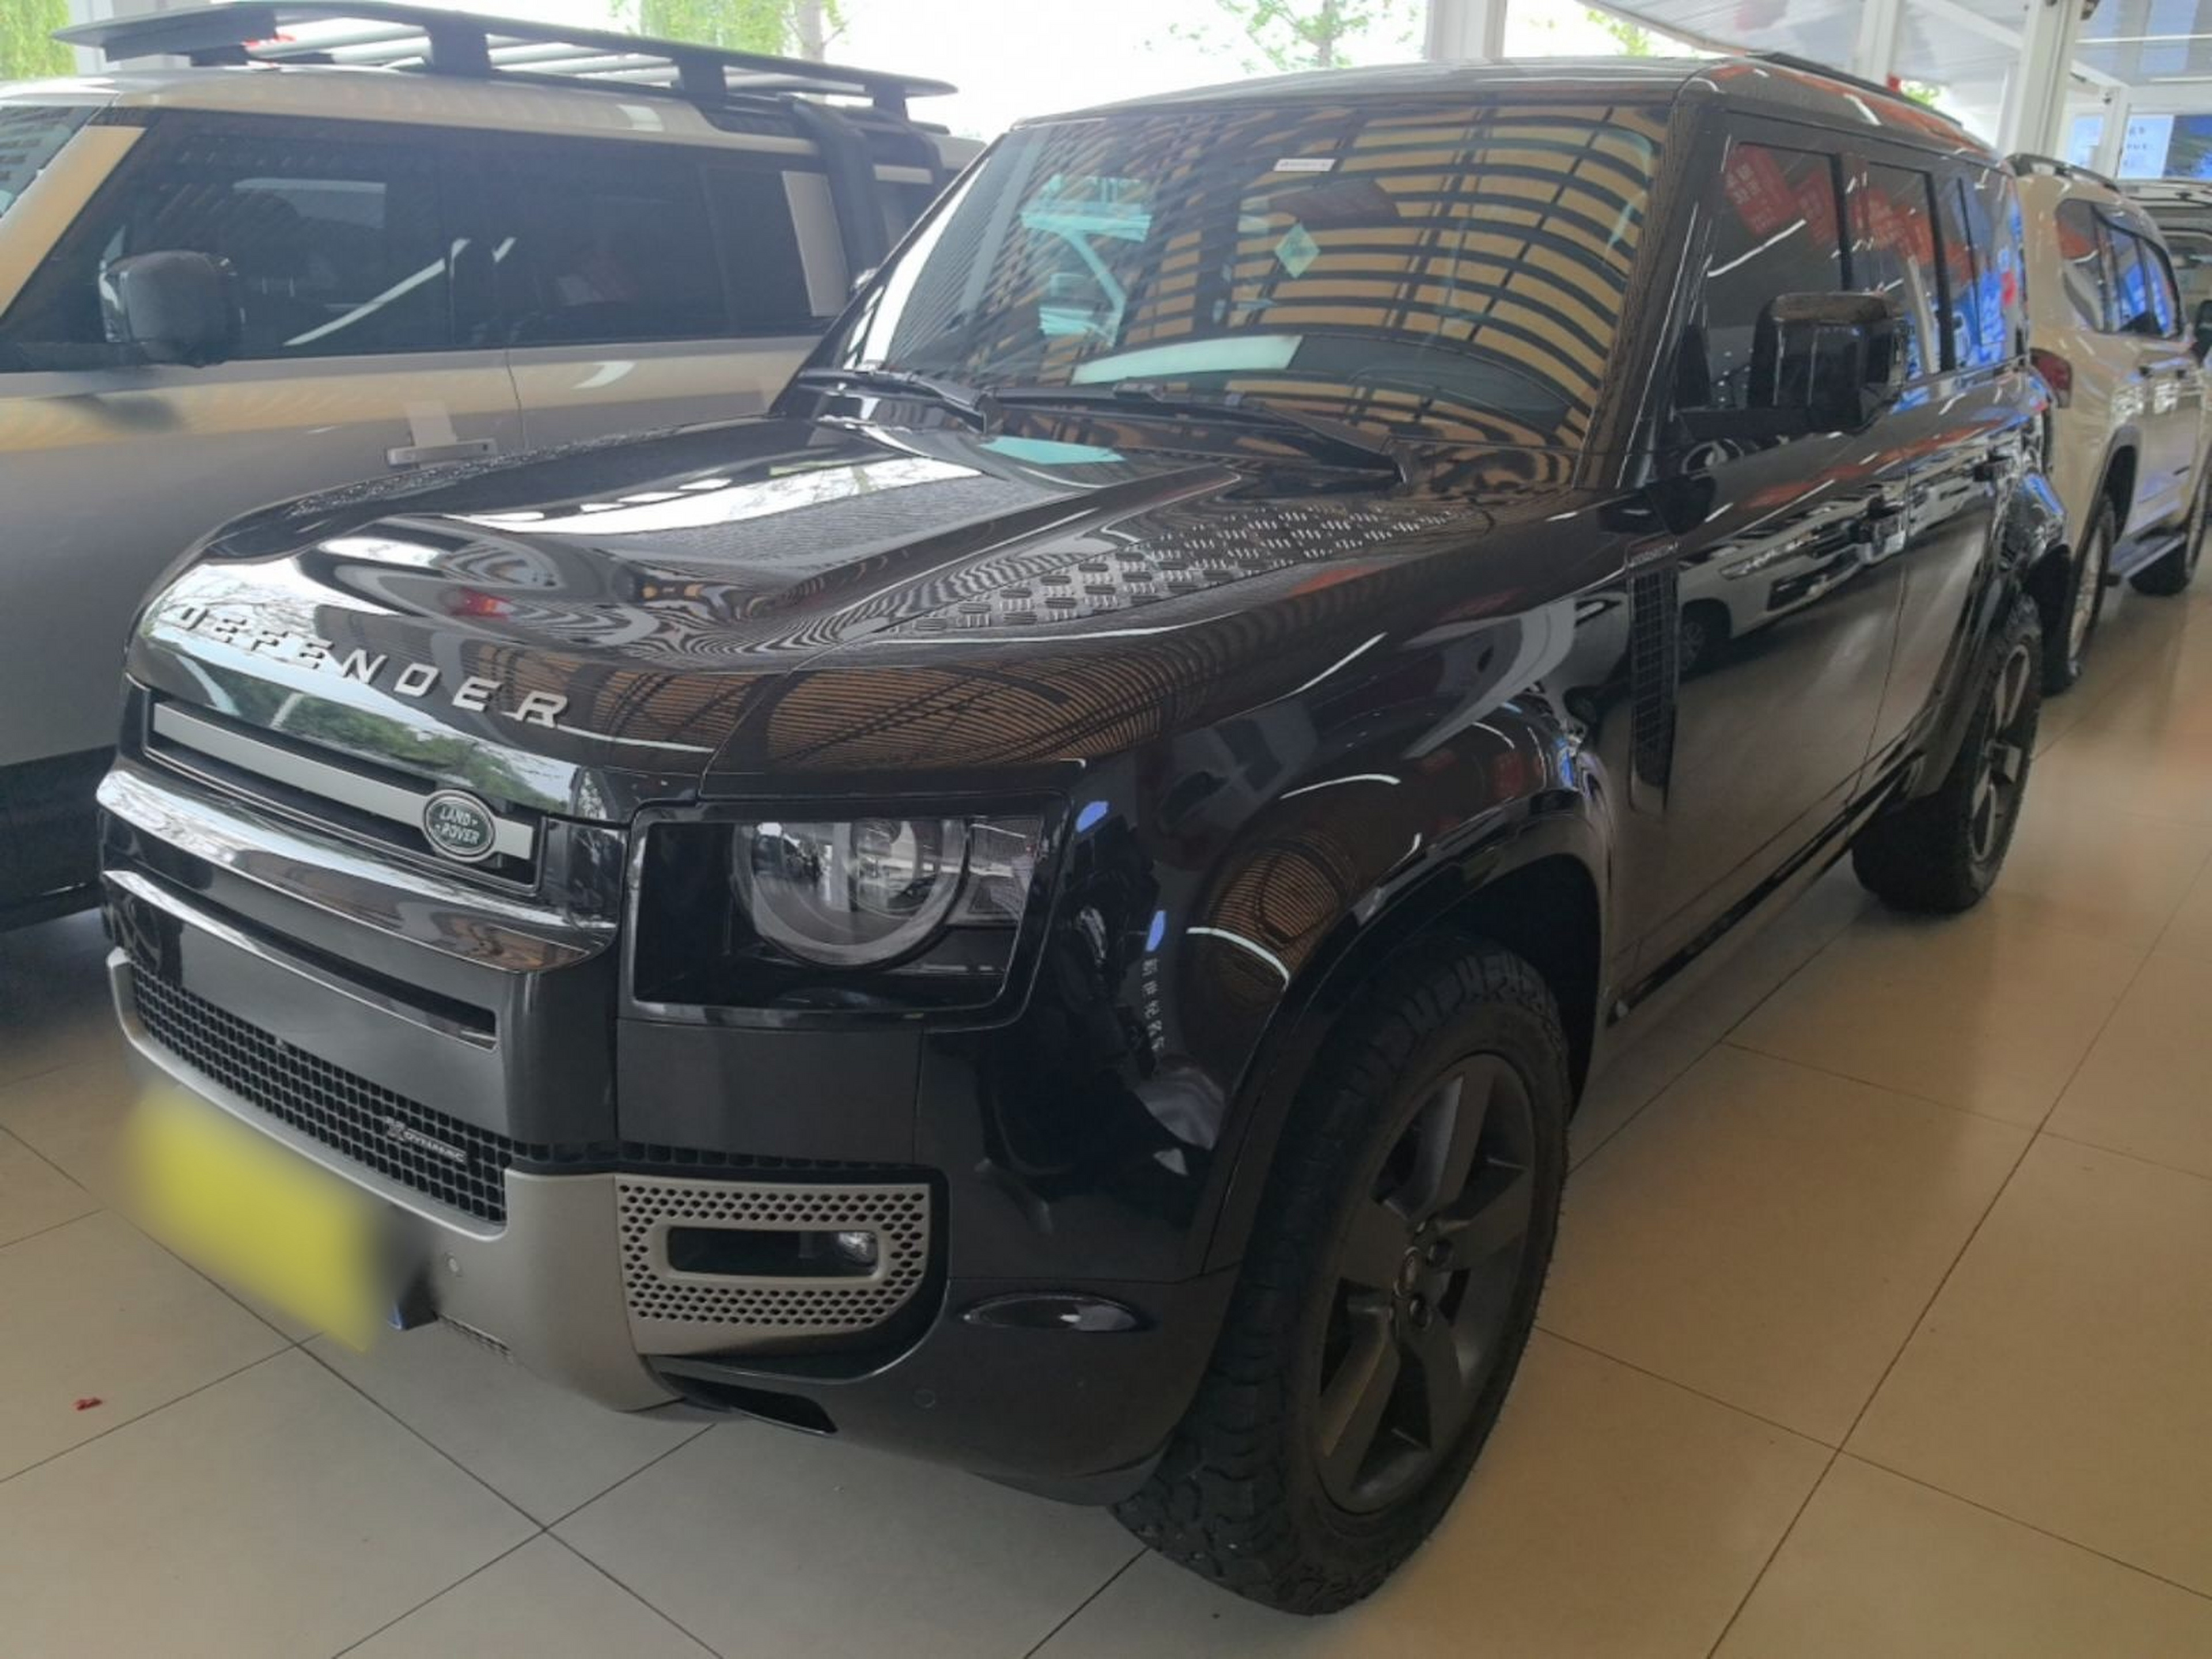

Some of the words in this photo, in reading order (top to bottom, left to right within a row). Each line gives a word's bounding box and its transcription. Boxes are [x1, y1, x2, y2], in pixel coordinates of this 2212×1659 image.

[172, 603, 568, 728] DEFENDER
[439, 806, 471, 827] LAND
[441, 823, 480, 844] ROVER
